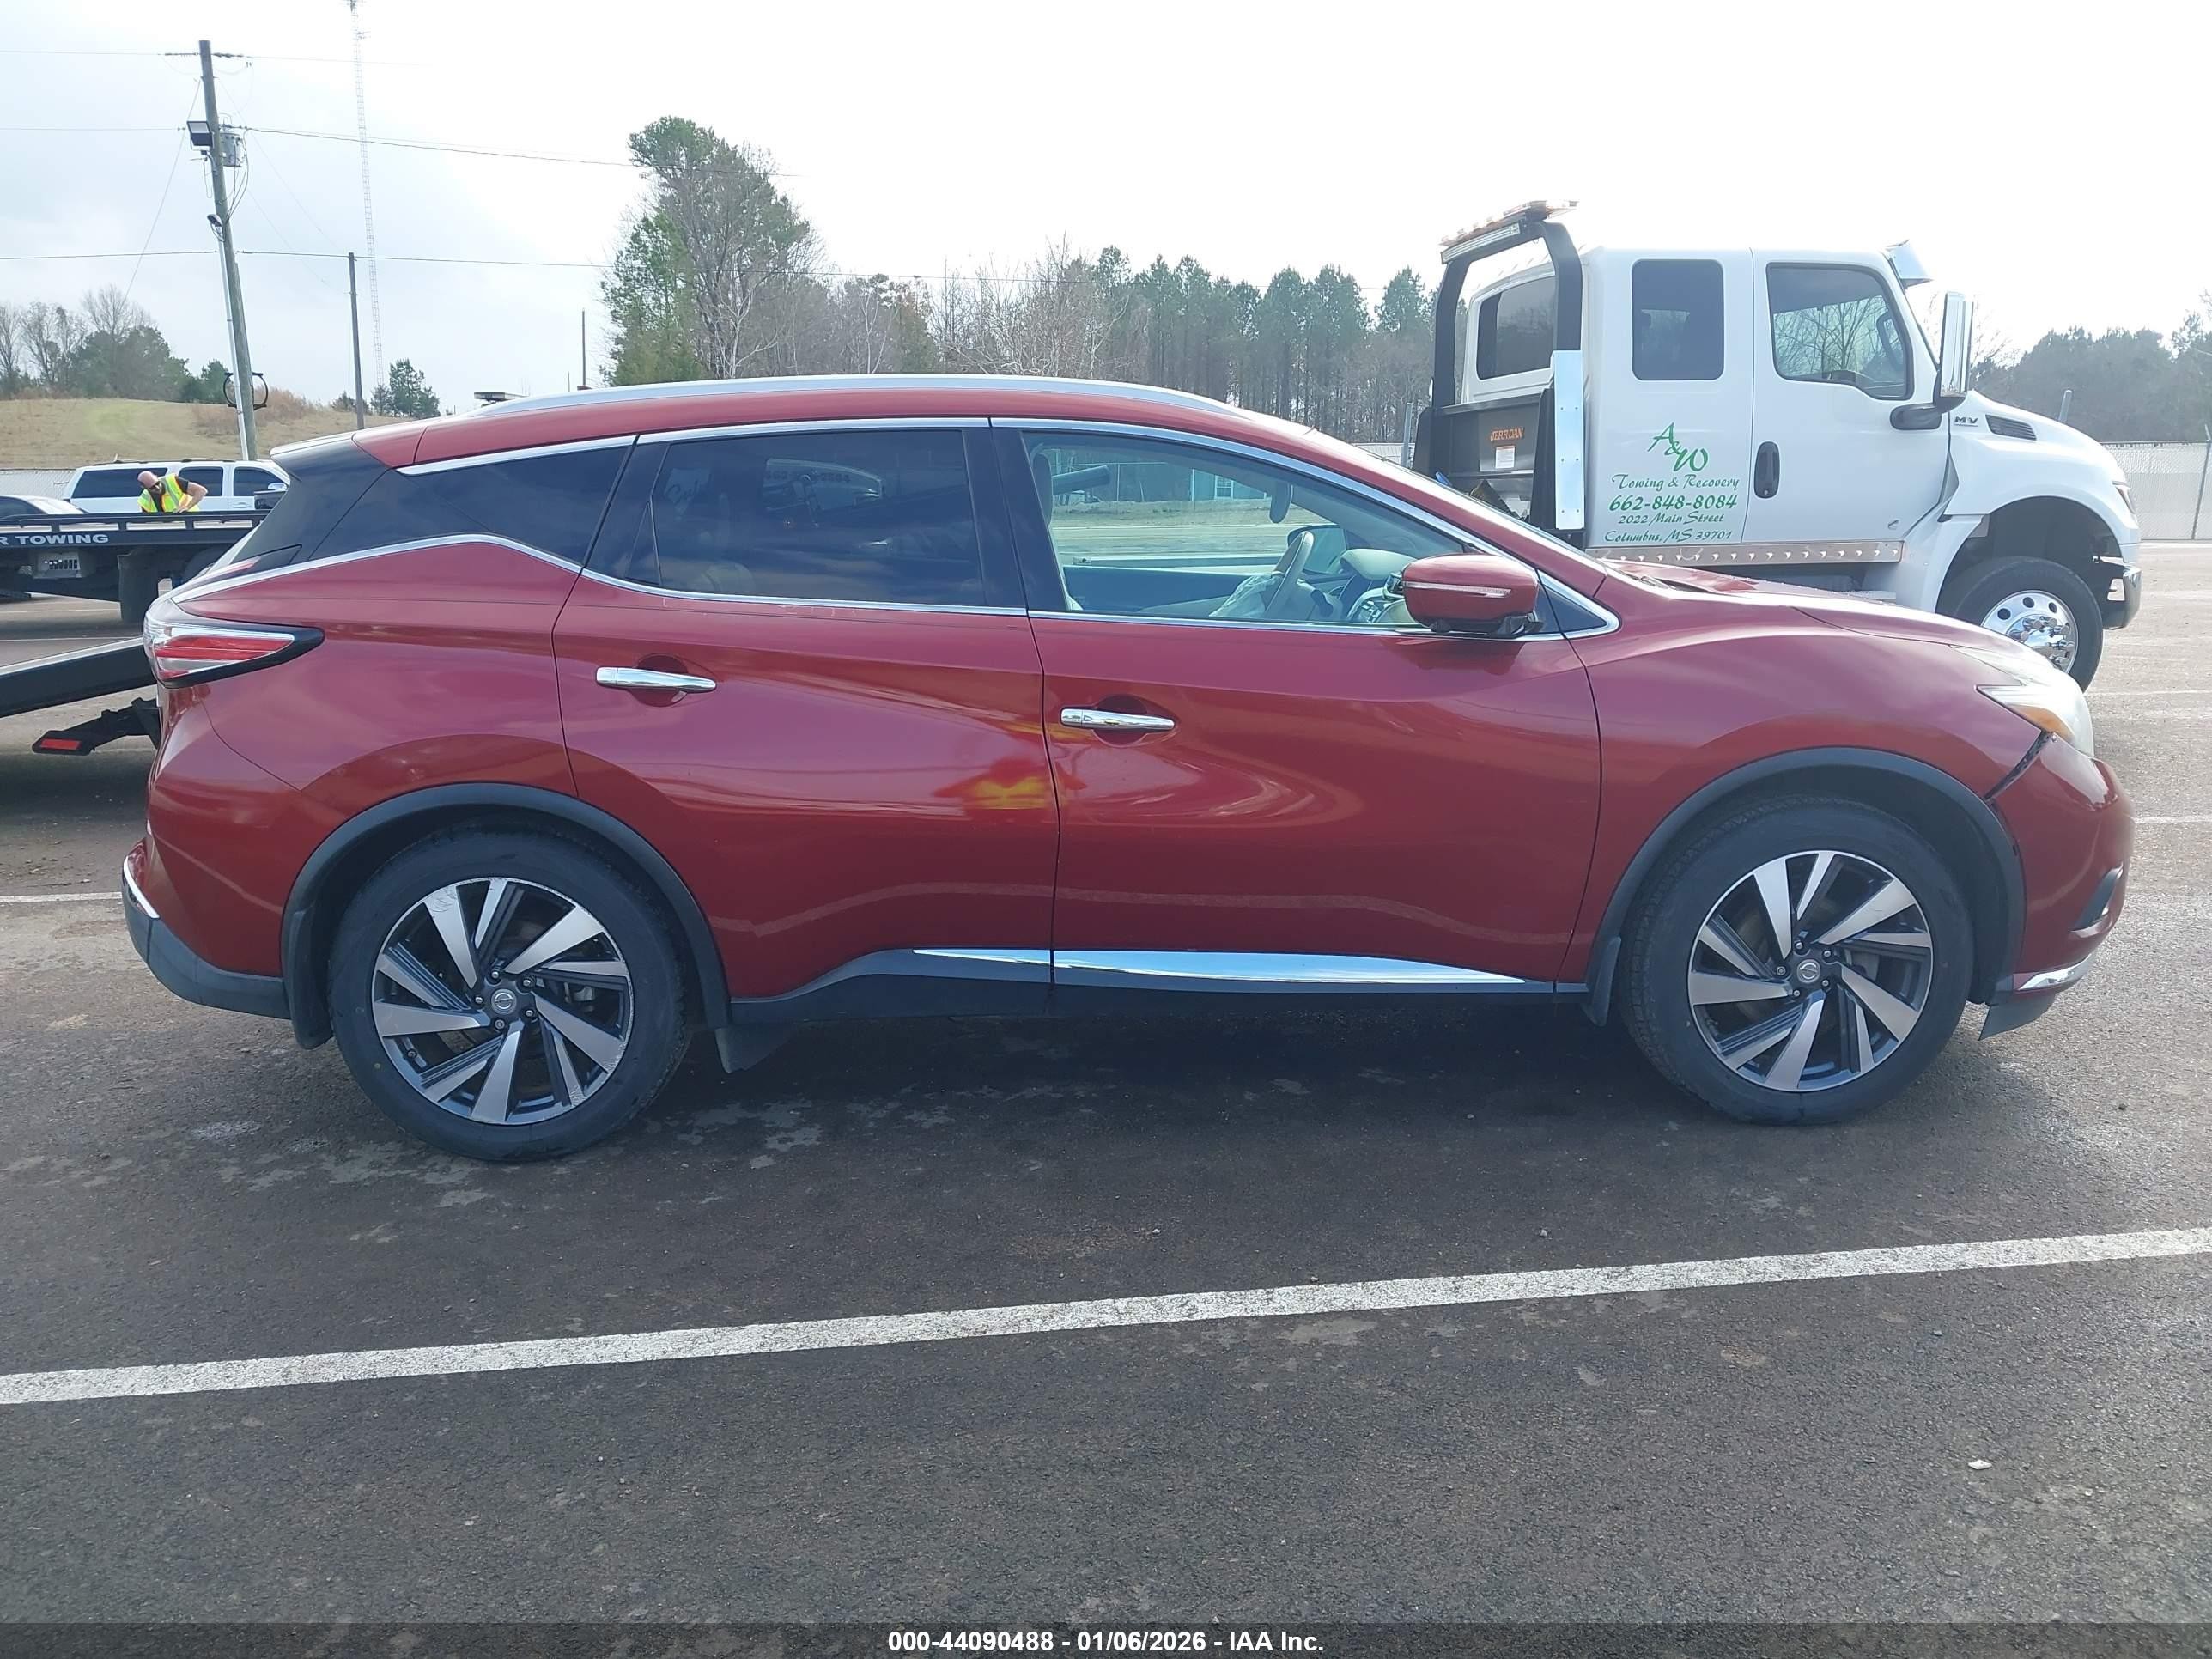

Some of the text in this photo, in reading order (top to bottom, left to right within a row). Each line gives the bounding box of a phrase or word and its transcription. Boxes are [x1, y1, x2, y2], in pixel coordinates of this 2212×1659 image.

[1954, 416, 1979, 424] MV
[1647, 422, 1709, 472] A&W
[1611, 474, 1740, 492] Towing & Recovery
[1609, 494, 1738, 512] 662-848-8084
[1618, 510, 1725, 526] 2022 Main Street
[15, 533, 109, 545] TOWING
[1604, 528, 1733, 544] Columbus, MS 39701
